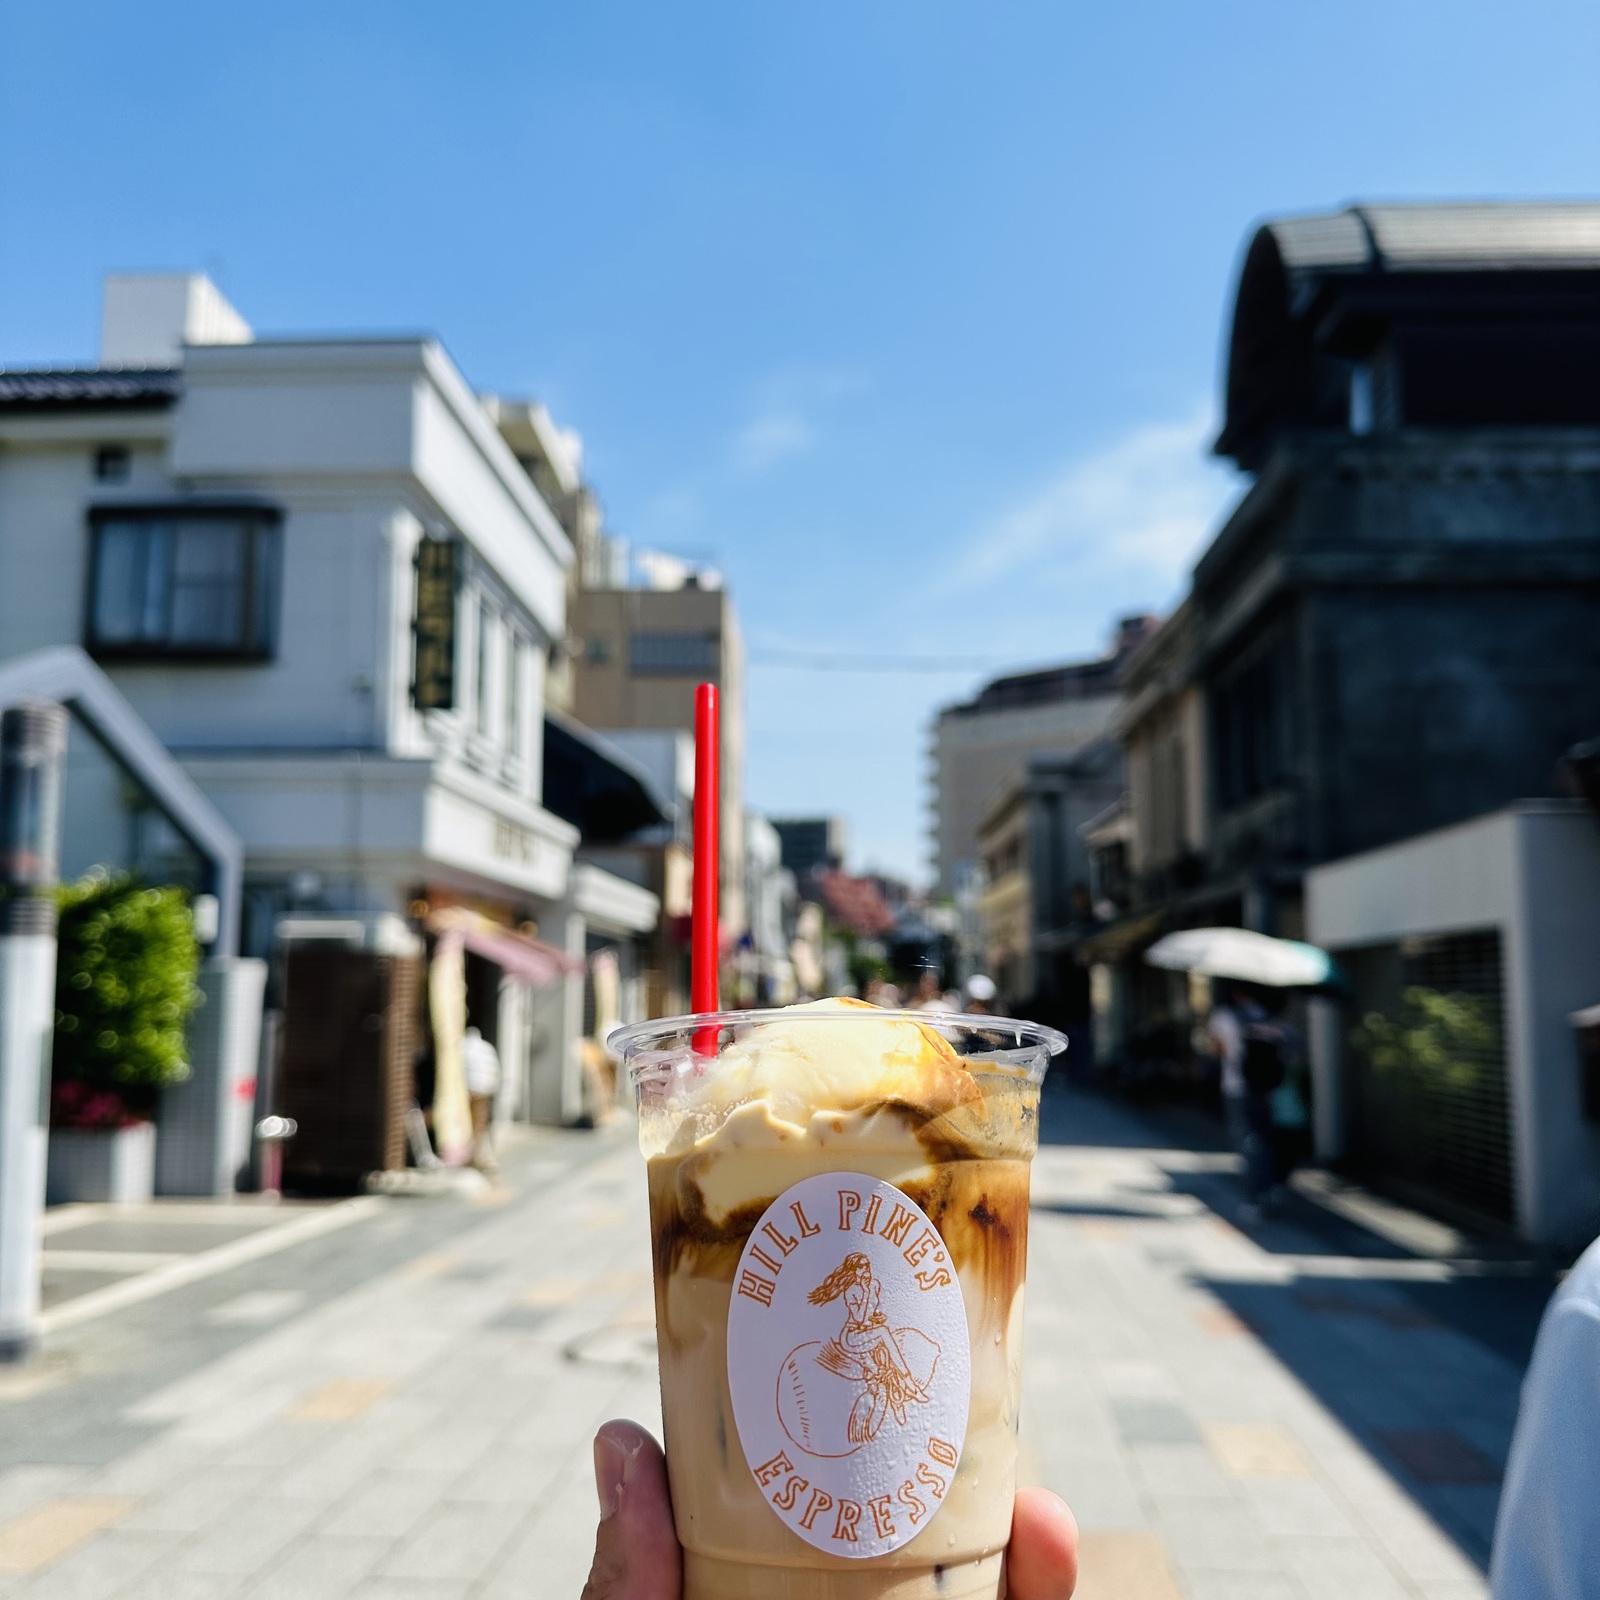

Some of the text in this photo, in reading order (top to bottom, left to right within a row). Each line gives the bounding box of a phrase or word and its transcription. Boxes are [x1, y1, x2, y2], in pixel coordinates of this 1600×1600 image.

[738, 1190, 951, 1307] HILL PINE'S
[754, 1437, 958, 1542] ESPRESSO
